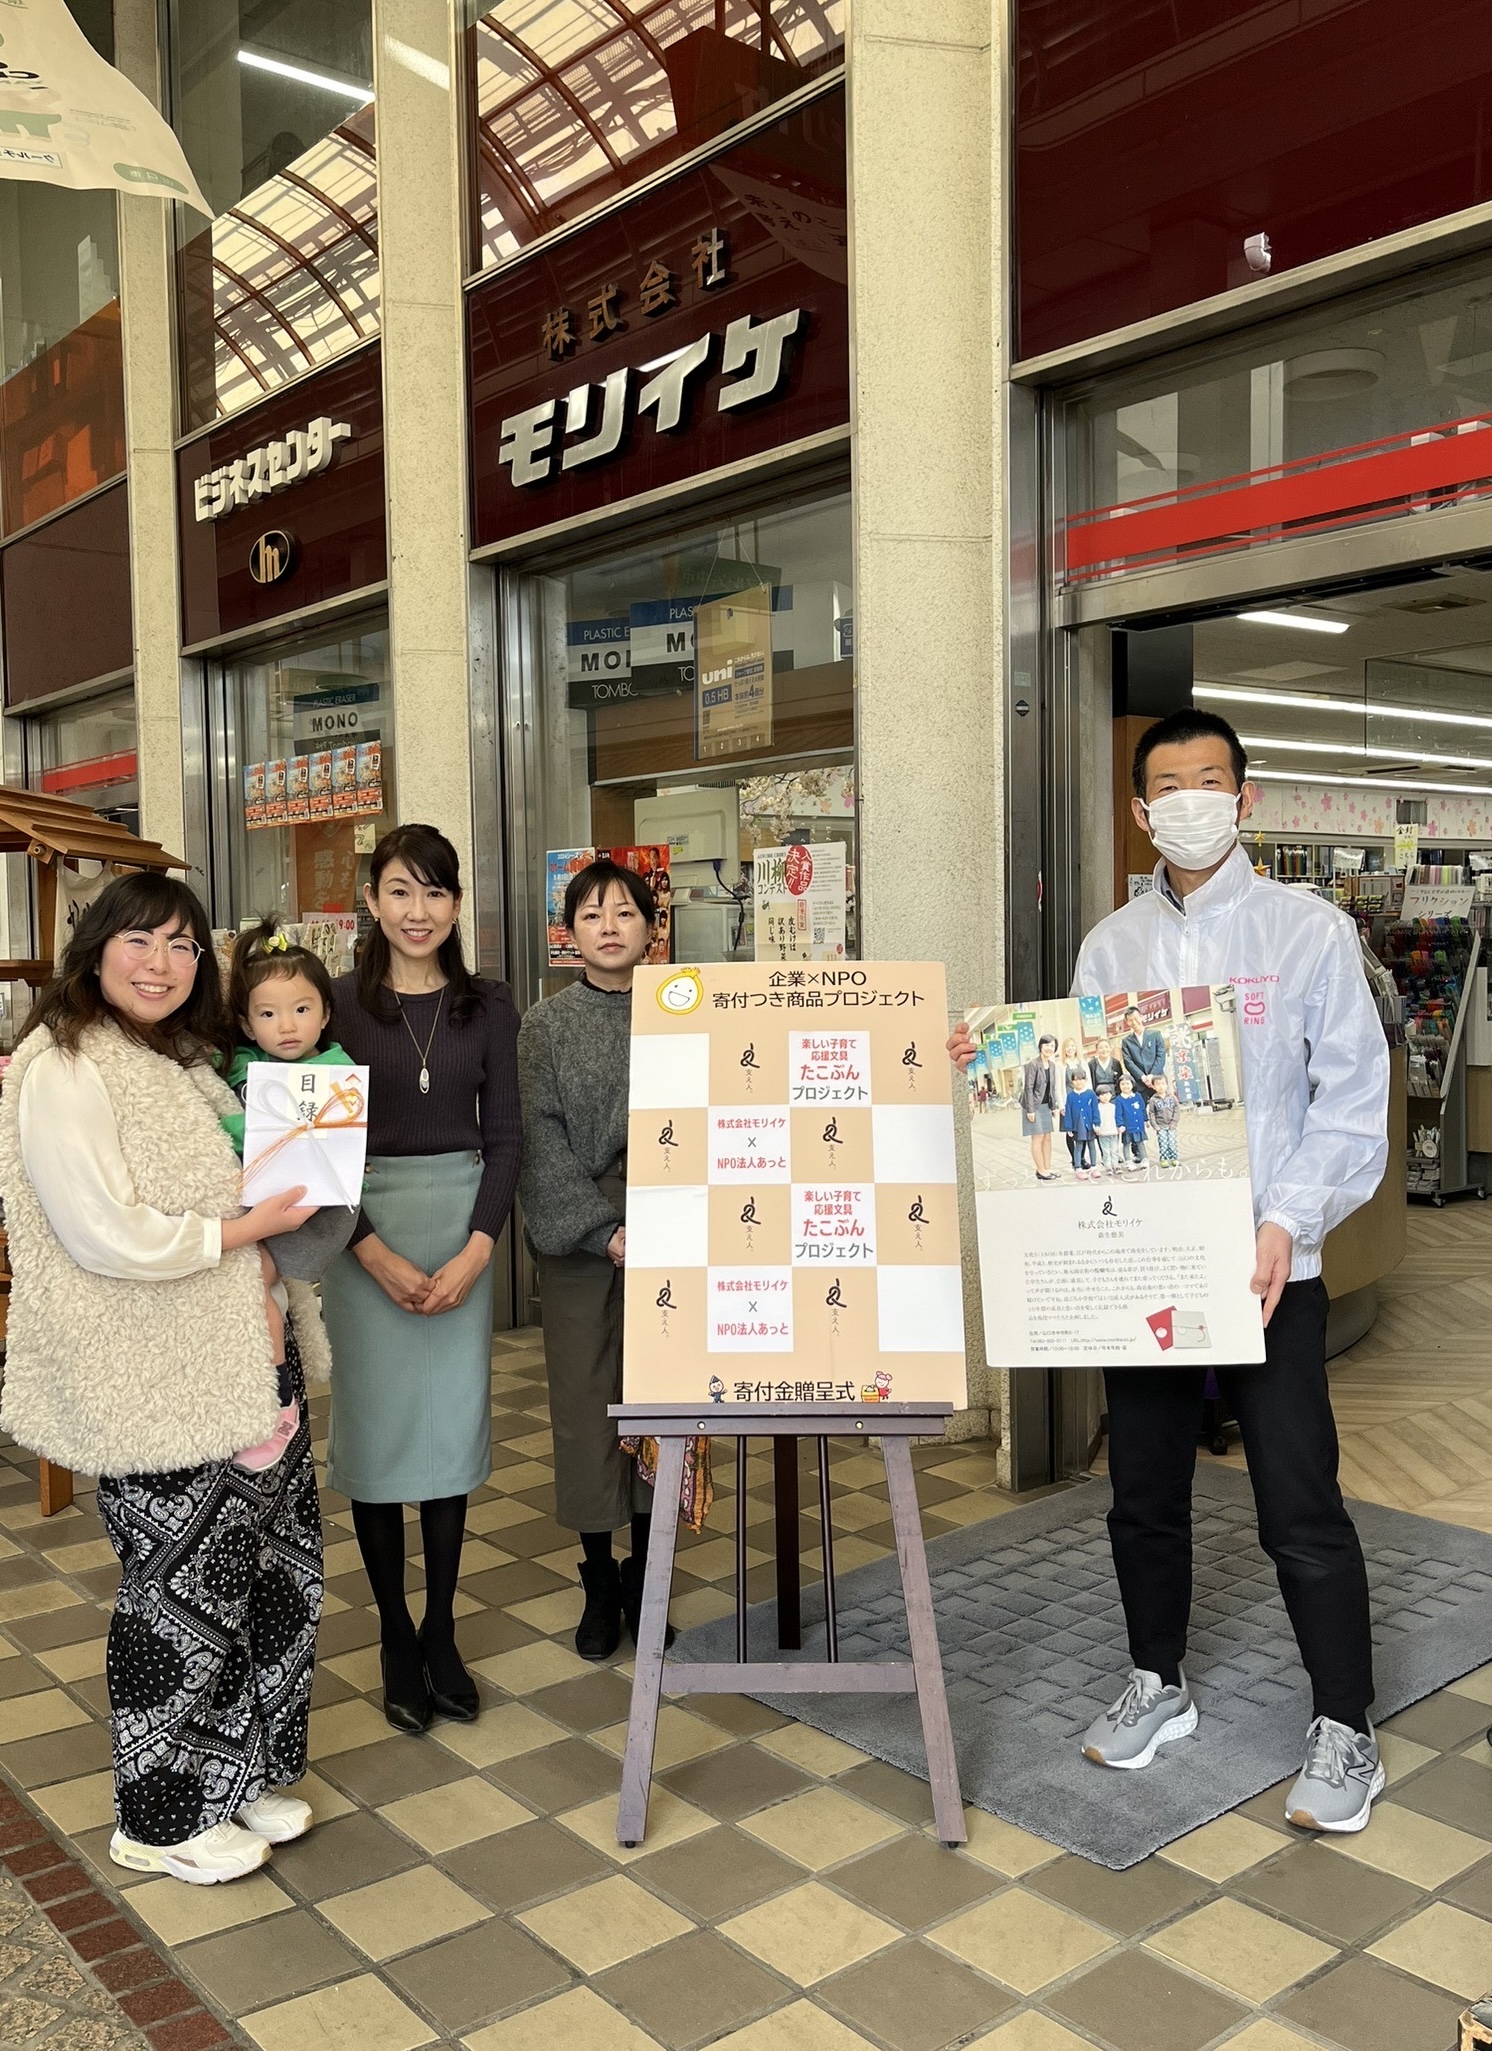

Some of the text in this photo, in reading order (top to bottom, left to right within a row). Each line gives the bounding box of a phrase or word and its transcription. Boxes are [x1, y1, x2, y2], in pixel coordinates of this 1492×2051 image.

[541, 227, 732, 356] 株式会社
[498, 308, 802, 488] モリイケ
[194, 416, 352, 522] ビジネスセンター
[584, 628, 620, 640] PLASTIC
[702, 659, 733, 685] uni
[705, 688, 729, 705] 0.5 HB
[312, 712, 358, 732] MONO
[799, 850, 812, 892] 入賞作品
[757, 884, 788, 895] コンテスト
[1410, 895, 1468, 906] フリクション
[768, 971, 867, 987] 企業×NPO
[1229, 975, 1280, 984] KOKUYO
[712, 990, 925, 1009] 寄付つき商品プロジェクト
[1244, 992, 1265, 1001] SOFT
[1243, 1016, 1265, 1025] RING
[802, 1038, 857, 1049] 楽しい子育て
[811, 1050, 848, 1061] 応援文具
[800, 1064, 860, 1081] たこぶん
[297, 1073, 318, 1122] 目録
[792, 1086, 868, 1101] プロジェクト
[717, 1118, 786, 1129] 株式会社モリイケ
[717, 1156, 787, 1170] NPO法人あっと
[978, 1157, 1250, 1191] ずっとここで、これからも。
[804, 1190, 861, 1202] 楽しい子育て
[814, 1204, 853, 1216] 応援文具
[803, 1219, 865, 1237] たこぶん
[1077, 1218, 1143, 1229] 株式会社モリイケ
[795, 1242, 874, 1259] プロジェクト
[717, 1280, 788, 1292] 株式会社モリイケ
[717, 1322, 789, 1336] NPO法人あっと
[733, 1381, 856, 1401] 寄付金贈呈式
